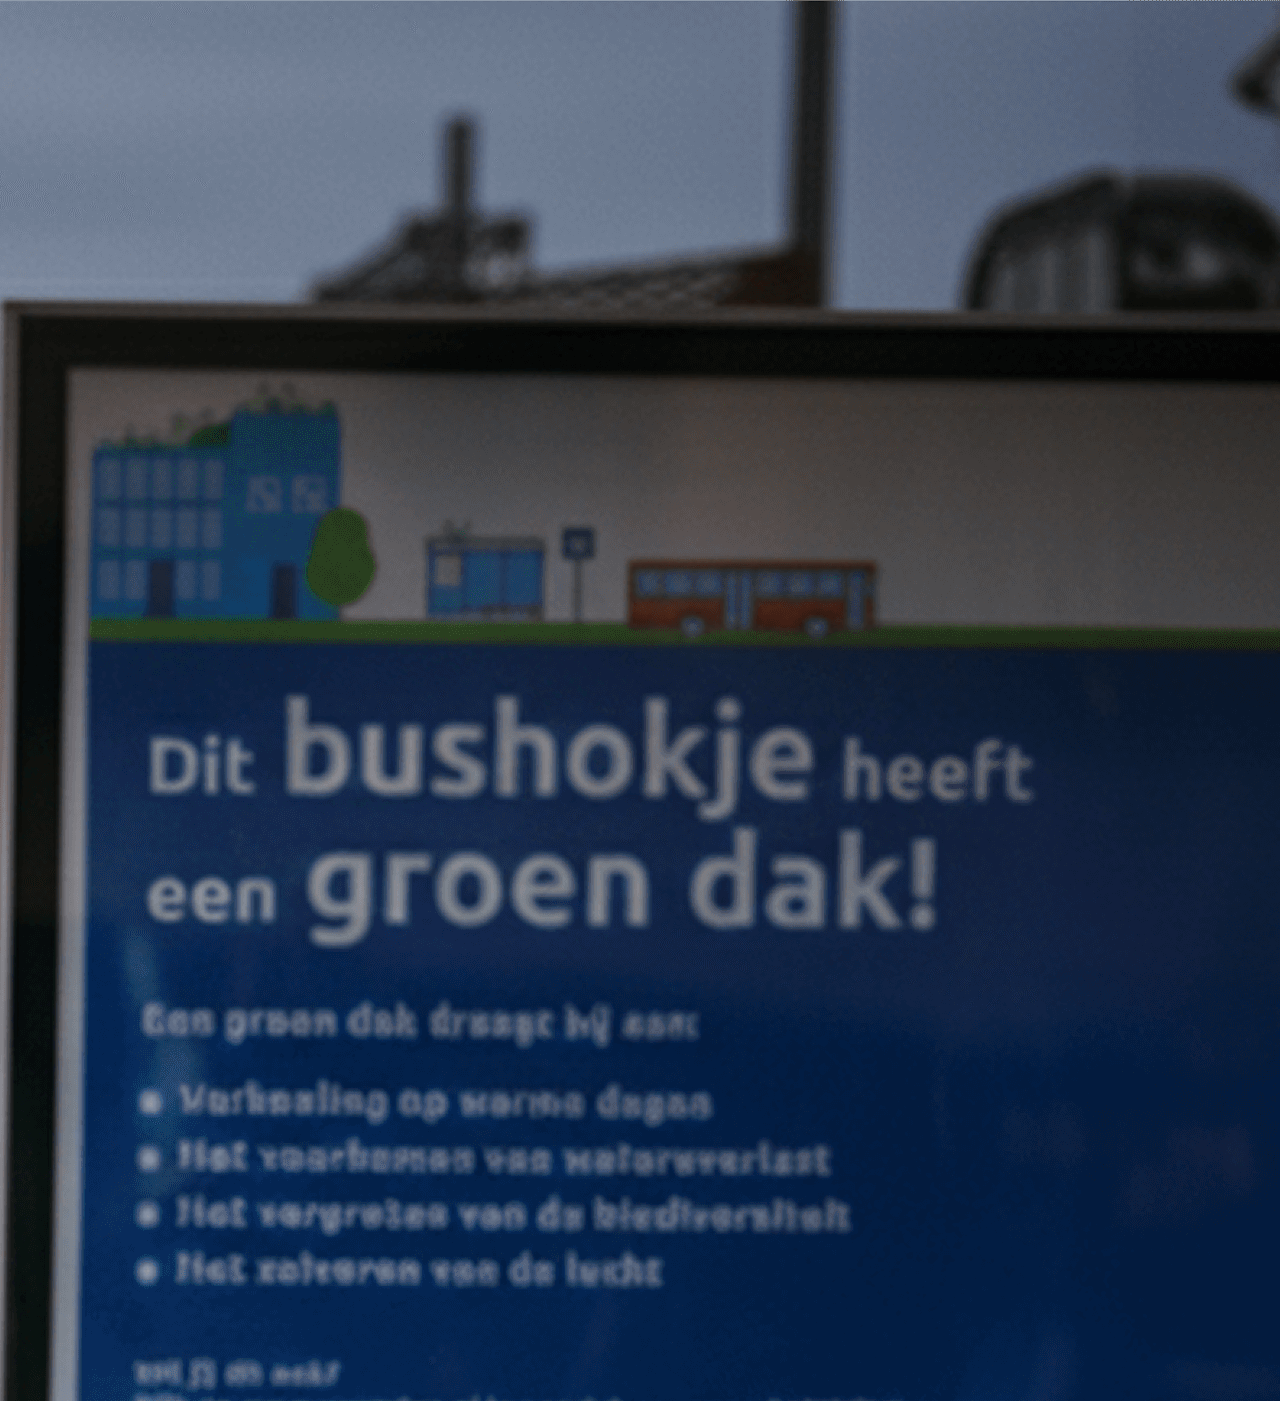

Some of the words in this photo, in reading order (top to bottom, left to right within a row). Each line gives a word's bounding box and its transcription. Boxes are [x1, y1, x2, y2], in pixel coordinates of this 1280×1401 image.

[148, 735, 257, 796] Dit
[284, 694, 816, 823] bushokje
[843, 736, 1033, 803] heeft
[144, 874, 278, 925] een
[306, 851, 651, 948] groen
[689, 827, 938, 931] dak!
[140, 1000, 217, 1039] Een
[223, 1006, 339, 1047] groen
[345, 1000, 419, 1039] dak
[397, 1089, 450, 1123] op
[595, 1085, 714, 1127] dagen
